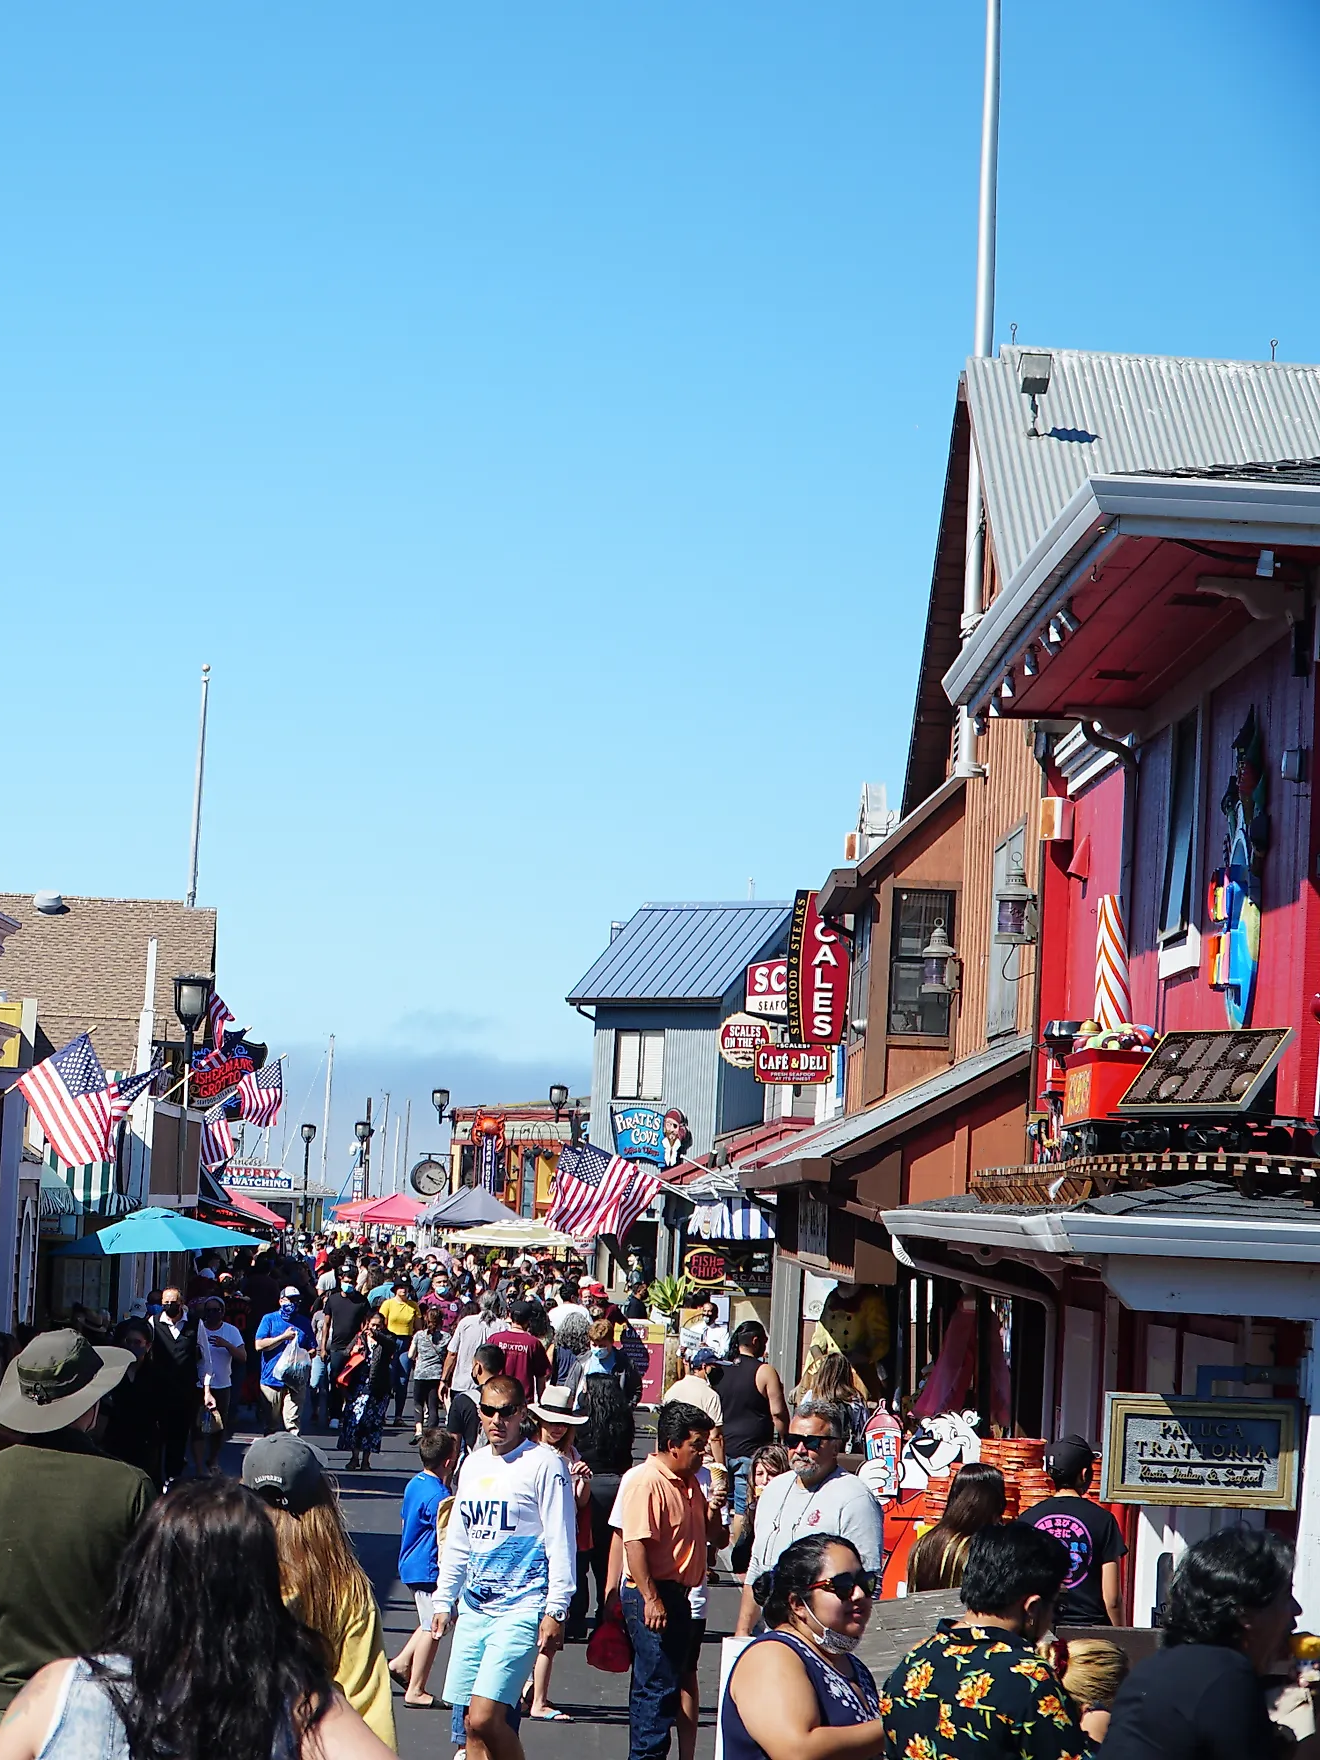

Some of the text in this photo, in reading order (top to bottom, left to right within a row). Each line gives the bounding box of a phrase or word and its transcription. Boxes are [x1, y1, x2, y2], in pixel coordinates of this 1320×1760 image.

[791, 898, 806, 950] STEAKS
[810, 915, 838, 1036] CALES
[789, 970, 799, 1035] SEAFOOD
[729, 1025, 761, 1037] SCALES
[724, 1037, 735, 1048] ON
[737, 1037, 753, 1047] THE
[759, 1053, 827, 1070] CAFÉ & DELI
[200, 1070, 241, 1097] GROTTO
[615, 1112, 661, 1134] PIRATE'S
[631, 1128, 659, 1146] COVE
[485, 1139, 493, 1162] CRAB
[229, 1157, 262, 1167] rincess
[232, 1177, 289, 1188] WATCHING
[692, 1255, 717, 1267] FISH
[691, 1266, 724, 1277] CHIPS
[1160, 1421, 1243, 1438] PALUCA
[870, 1438, 896, 1458] ICEE
[1135, 1440, 1269, 1459] TRATTORIA
[1139, 1465, 1260, 1484] Rustic Italian & Seafood
[460, 1500, 516, 1531] SWFL
[471, 1530, 496, 1540] 2021
